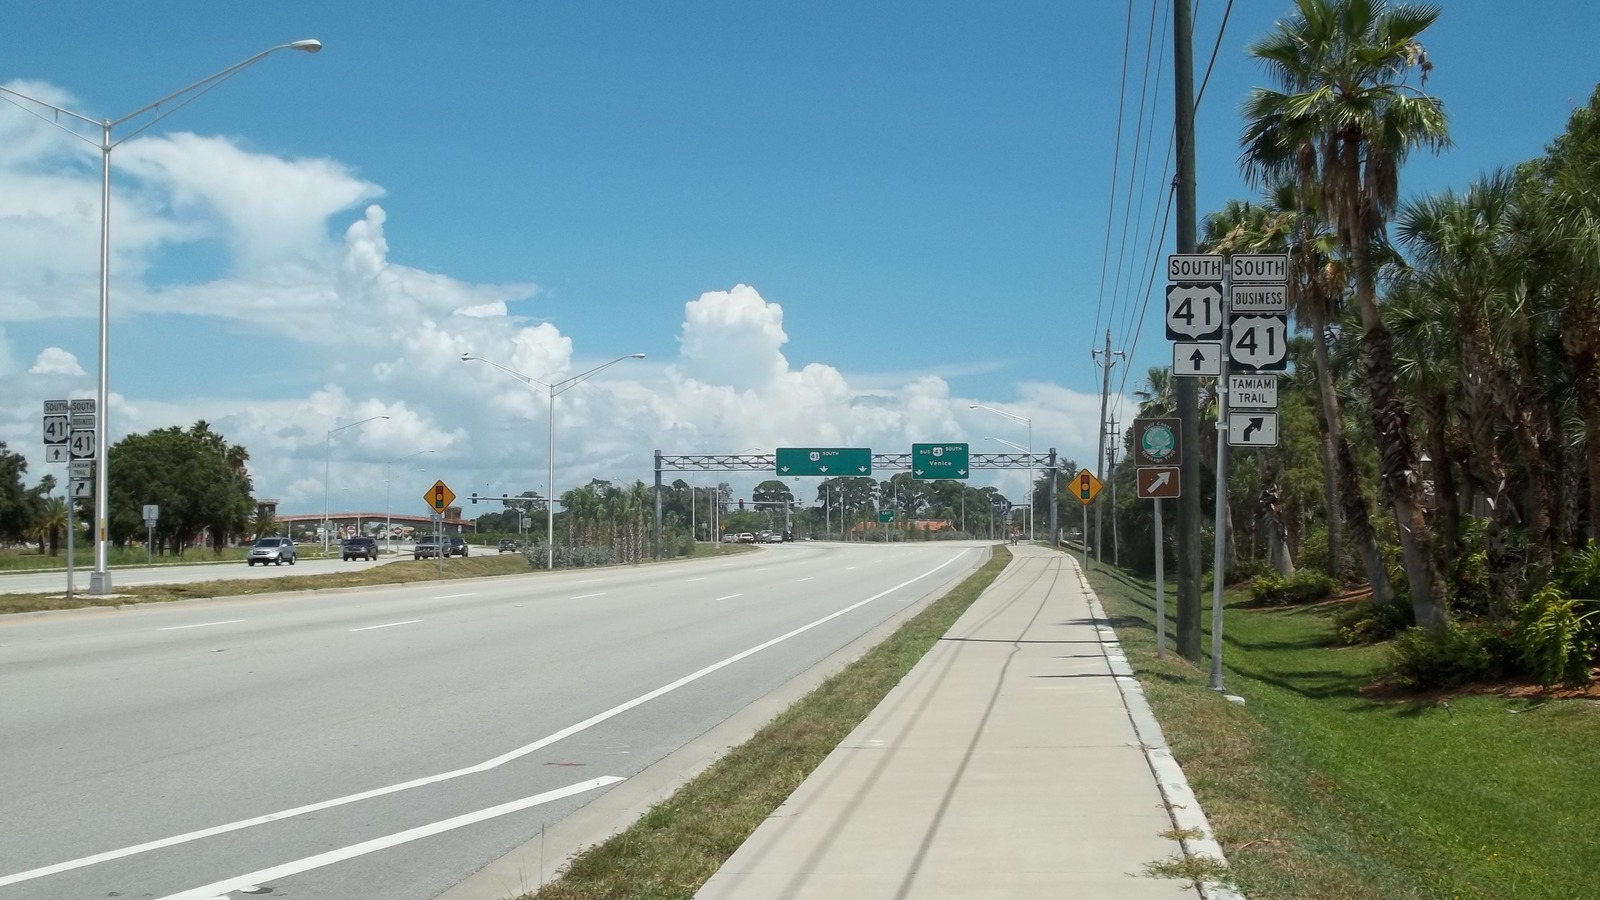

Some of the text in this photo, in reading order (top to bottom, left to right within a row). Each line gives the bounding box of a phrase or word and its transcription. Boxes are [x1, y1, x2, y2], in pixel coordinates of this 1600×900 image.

[1171, 259, 1221, 276] SOUTH
[1234, 259, 1285, 276] SOUTH
[1235, 291, 1283, 305] BUSINESS
[1172, 296, 1211, 326] 41
[1235, 326, 1275, 356] 41
[1232, 378, 1275, 390] TAMIAMI
[72, 401, 95, 411] SOUTH
[1238, 392, 1268, 404] TRAIL
[45, 402, 68, 412] SOUTH
[46, 421, 63, 437] 41
[73, 436, 90, 452] 41
